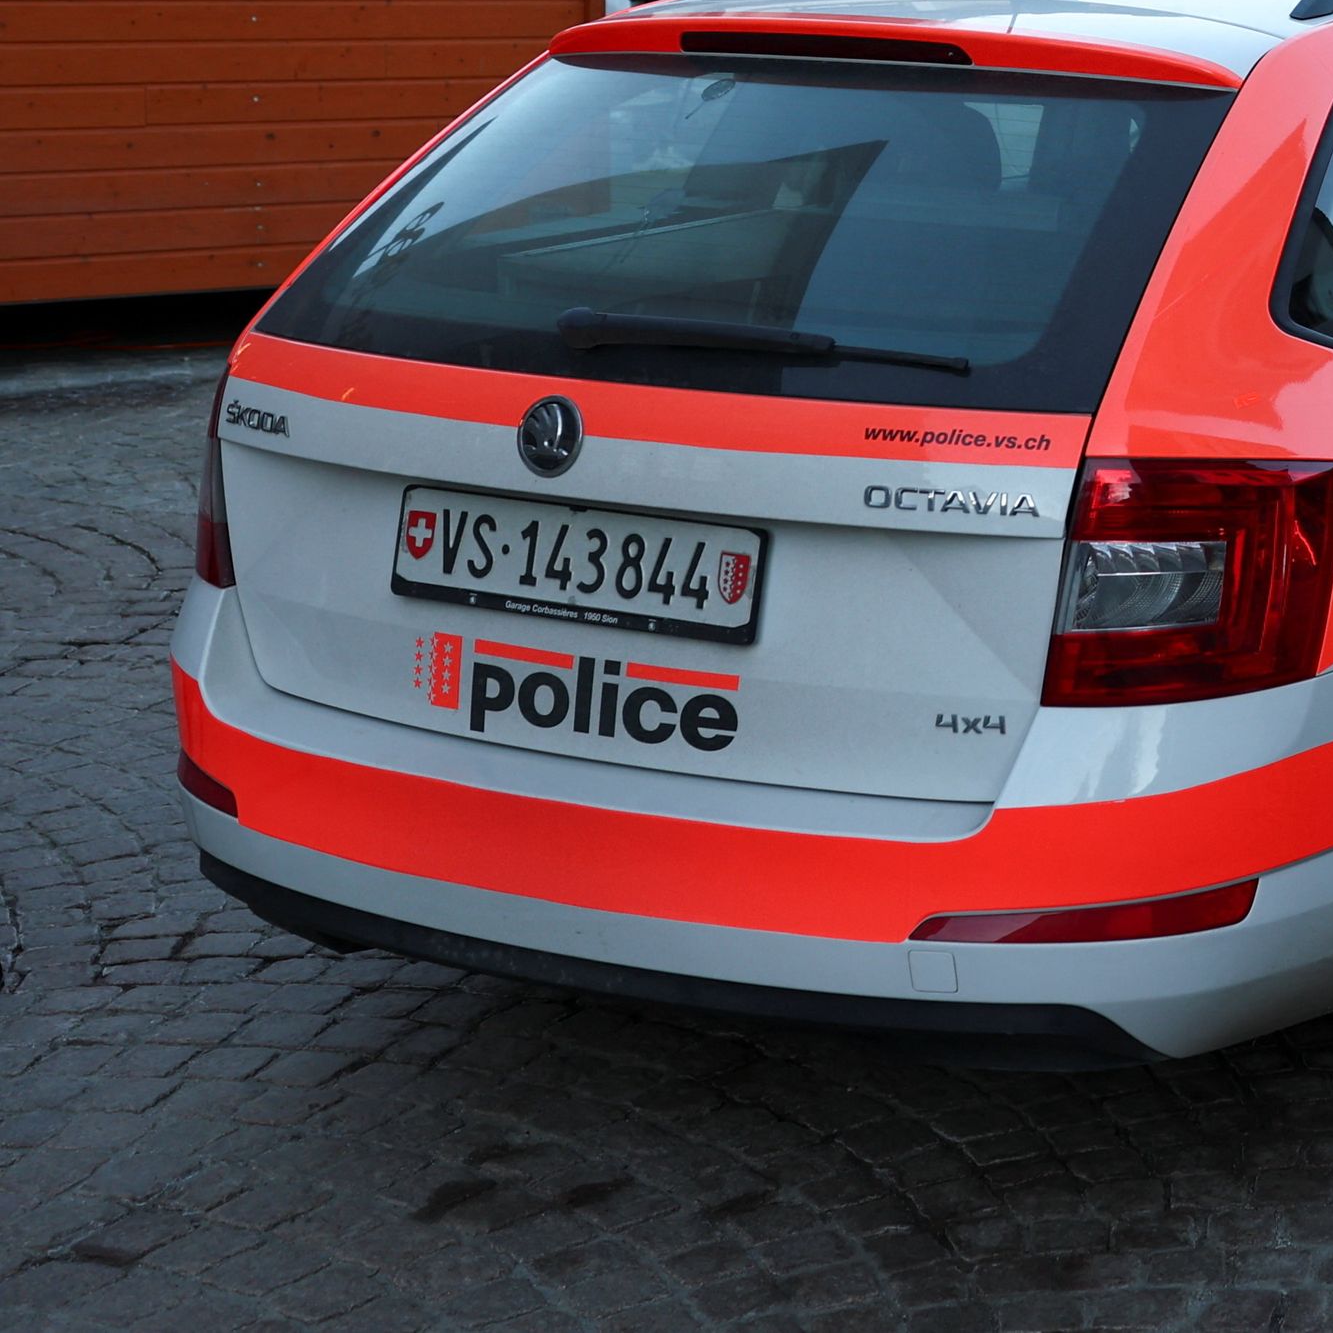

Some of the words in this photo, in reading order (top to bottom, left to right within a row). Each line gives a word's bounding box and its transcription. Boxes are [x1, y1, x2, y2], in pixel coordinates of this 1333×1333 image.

[225, 399, 291, 438] ŠKODA
[863, 427, 1052, 452] www.police.vs.ch
[863, 485, 1041, 519] OCTAVIA
[505, 600, 531, 613] Garage
[532, 604, 578, 618] Corbassières
[583, 611, 601, 622] 1950
[601, 614, 618, 625] Sion
[469, 655, 739, 753] police
[934, 711, 1008, 736] 4x4
